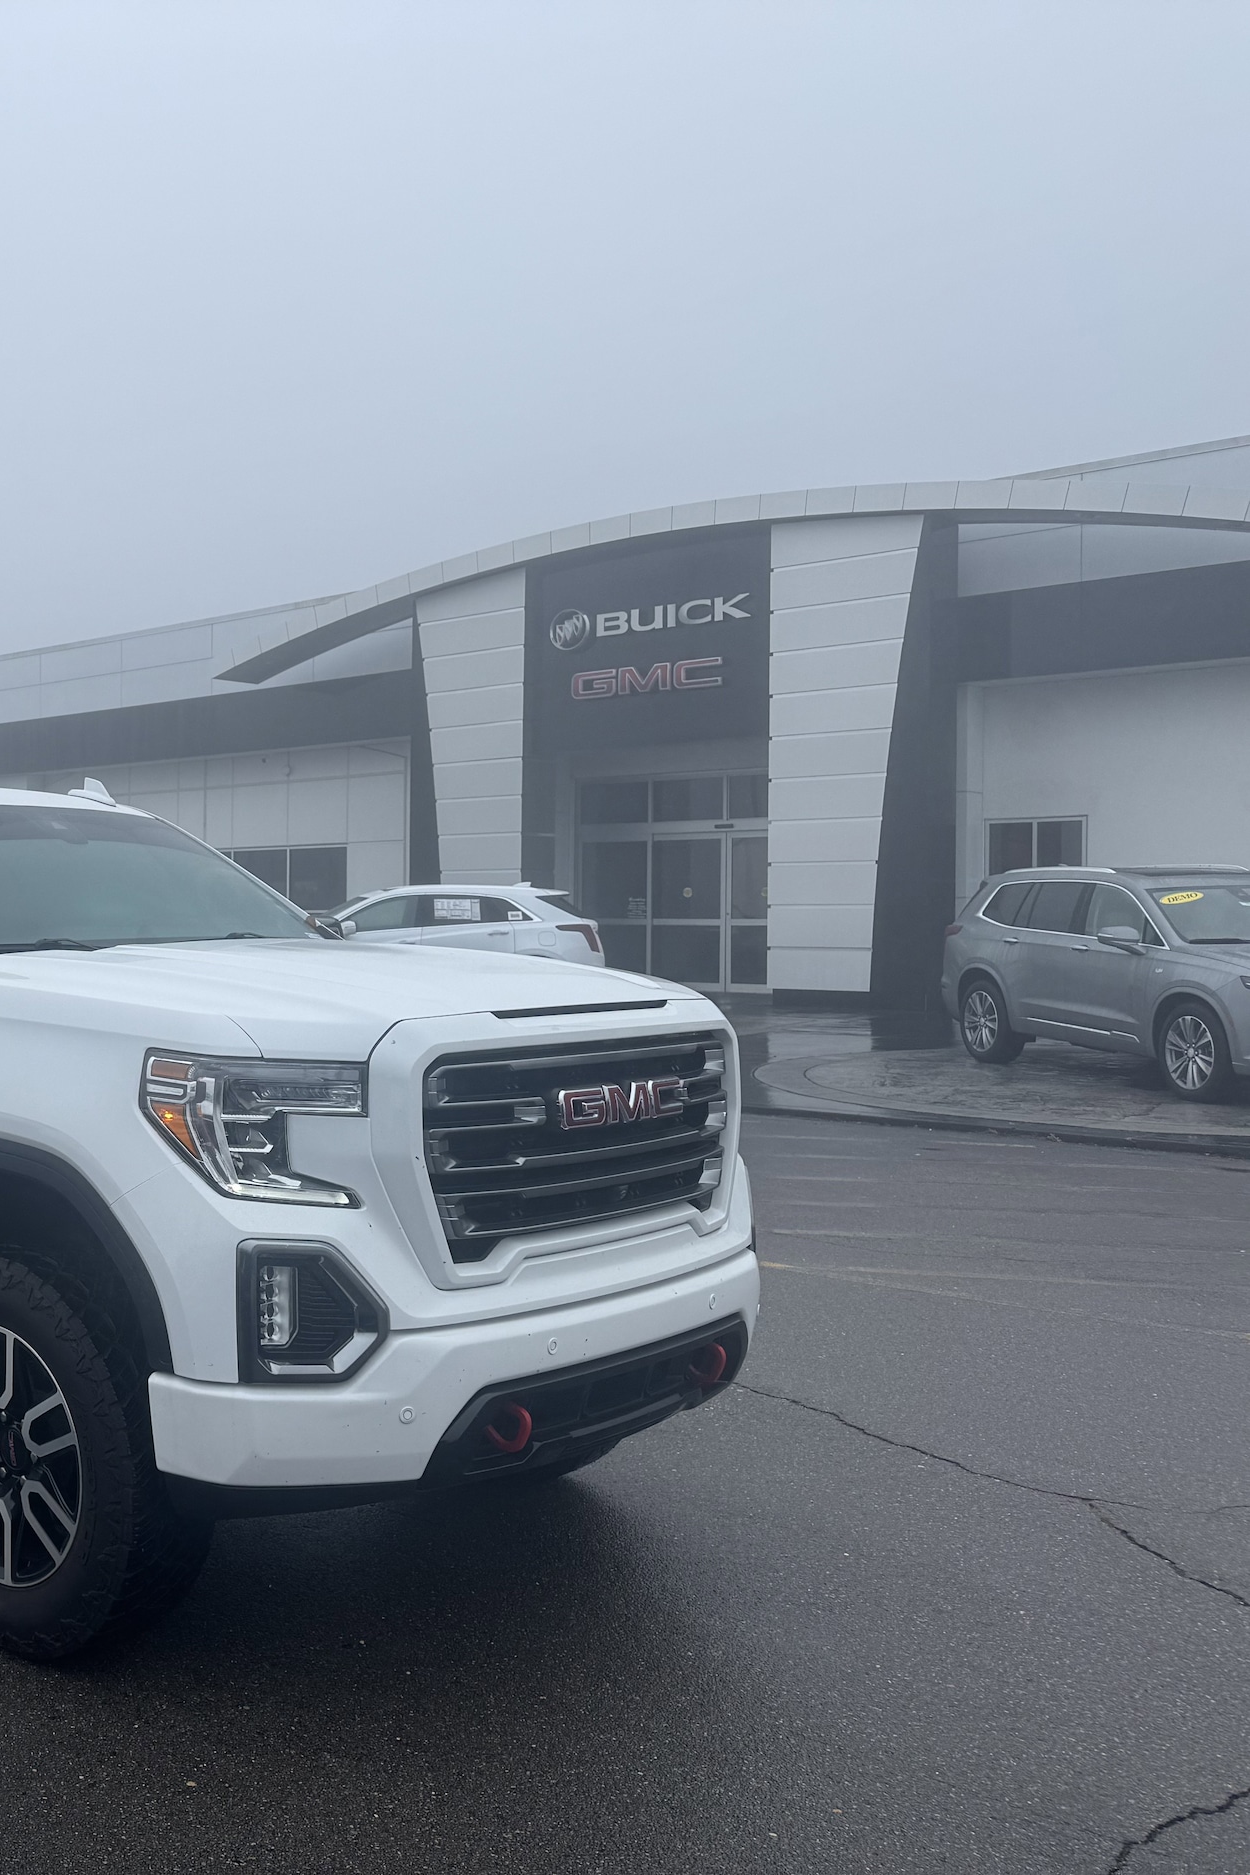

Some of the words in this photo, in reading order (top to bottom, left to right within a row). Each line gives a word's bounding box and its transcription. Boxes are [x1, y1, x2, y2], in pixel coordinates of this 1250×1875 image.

[596, 592, 751, 637] BUICK
[571, 656, 722, 699] GMC
[1167, 892, 1198, 904] DEMO
[558, 1076, 685, 1130] GMC
